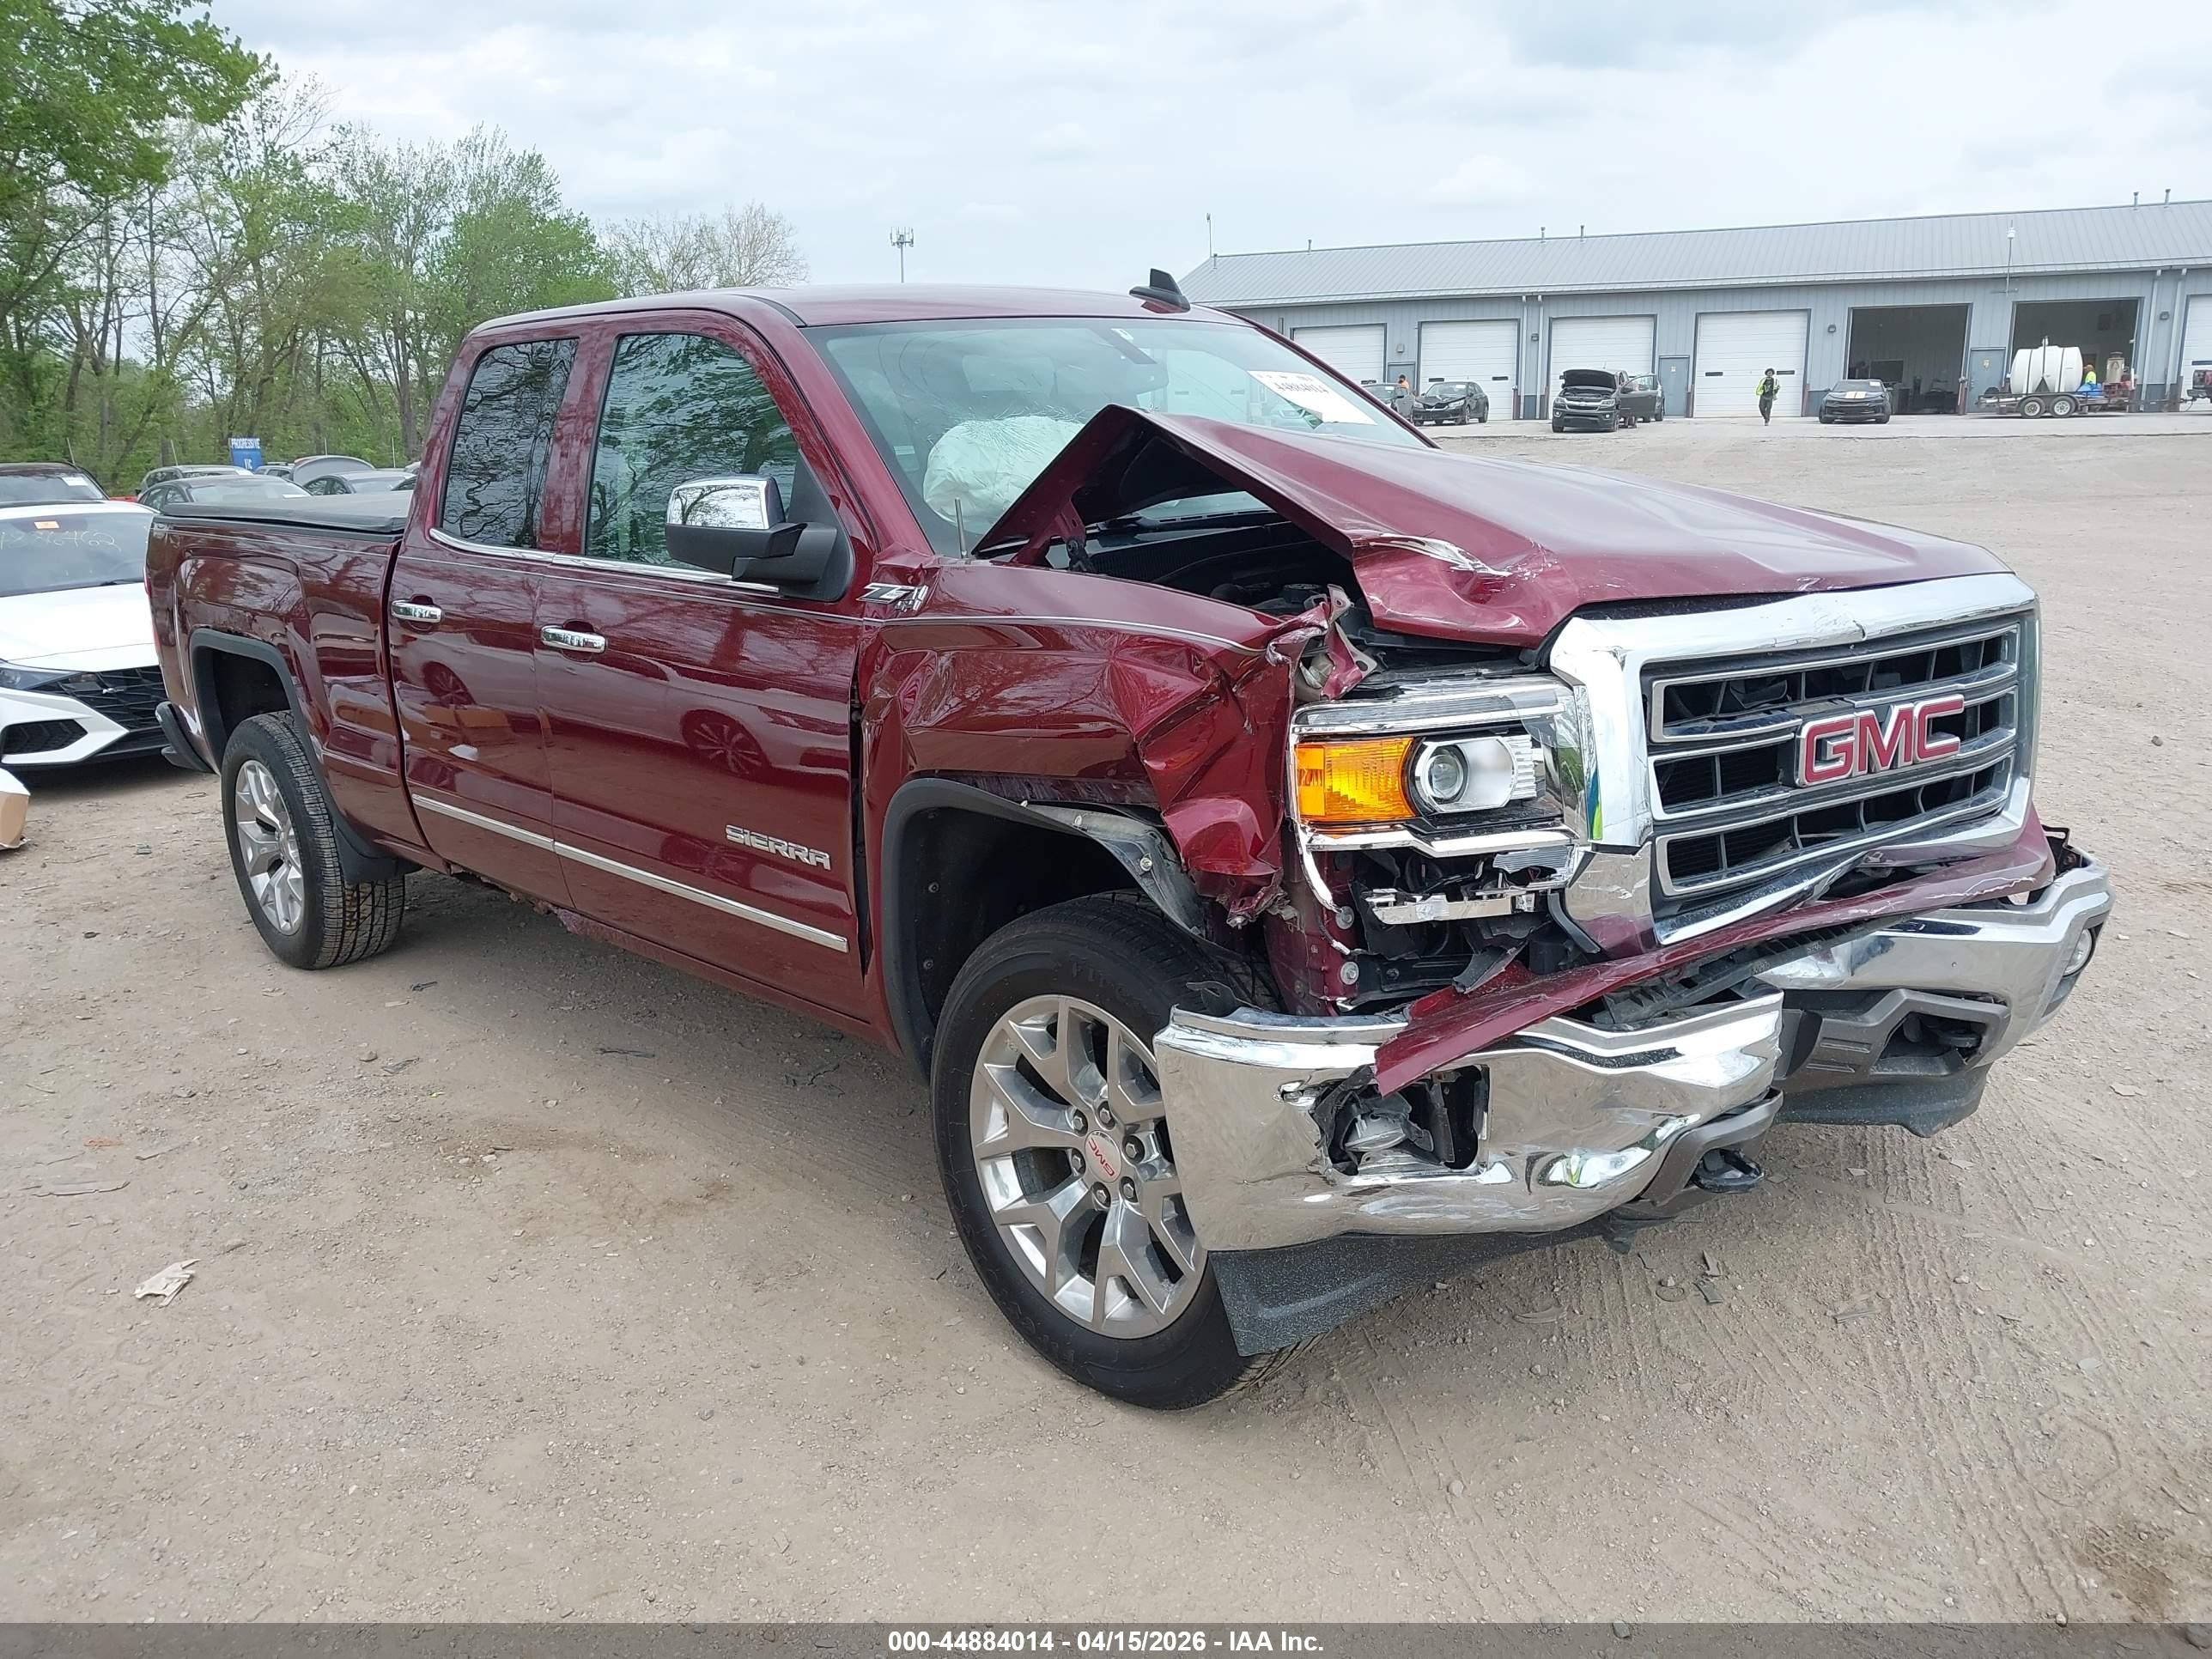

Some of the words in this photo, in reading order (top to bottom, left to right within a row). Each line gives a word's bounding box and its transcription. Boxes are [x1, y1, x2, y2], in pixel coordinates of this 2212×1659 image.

[231, 437, 261, 449] PROGRESSIVE
[1801, 694, 1965, 787] GMC
[725, 824, 831, 871] SIERRA
[1088, 1137, 1115, 1176] GMC
